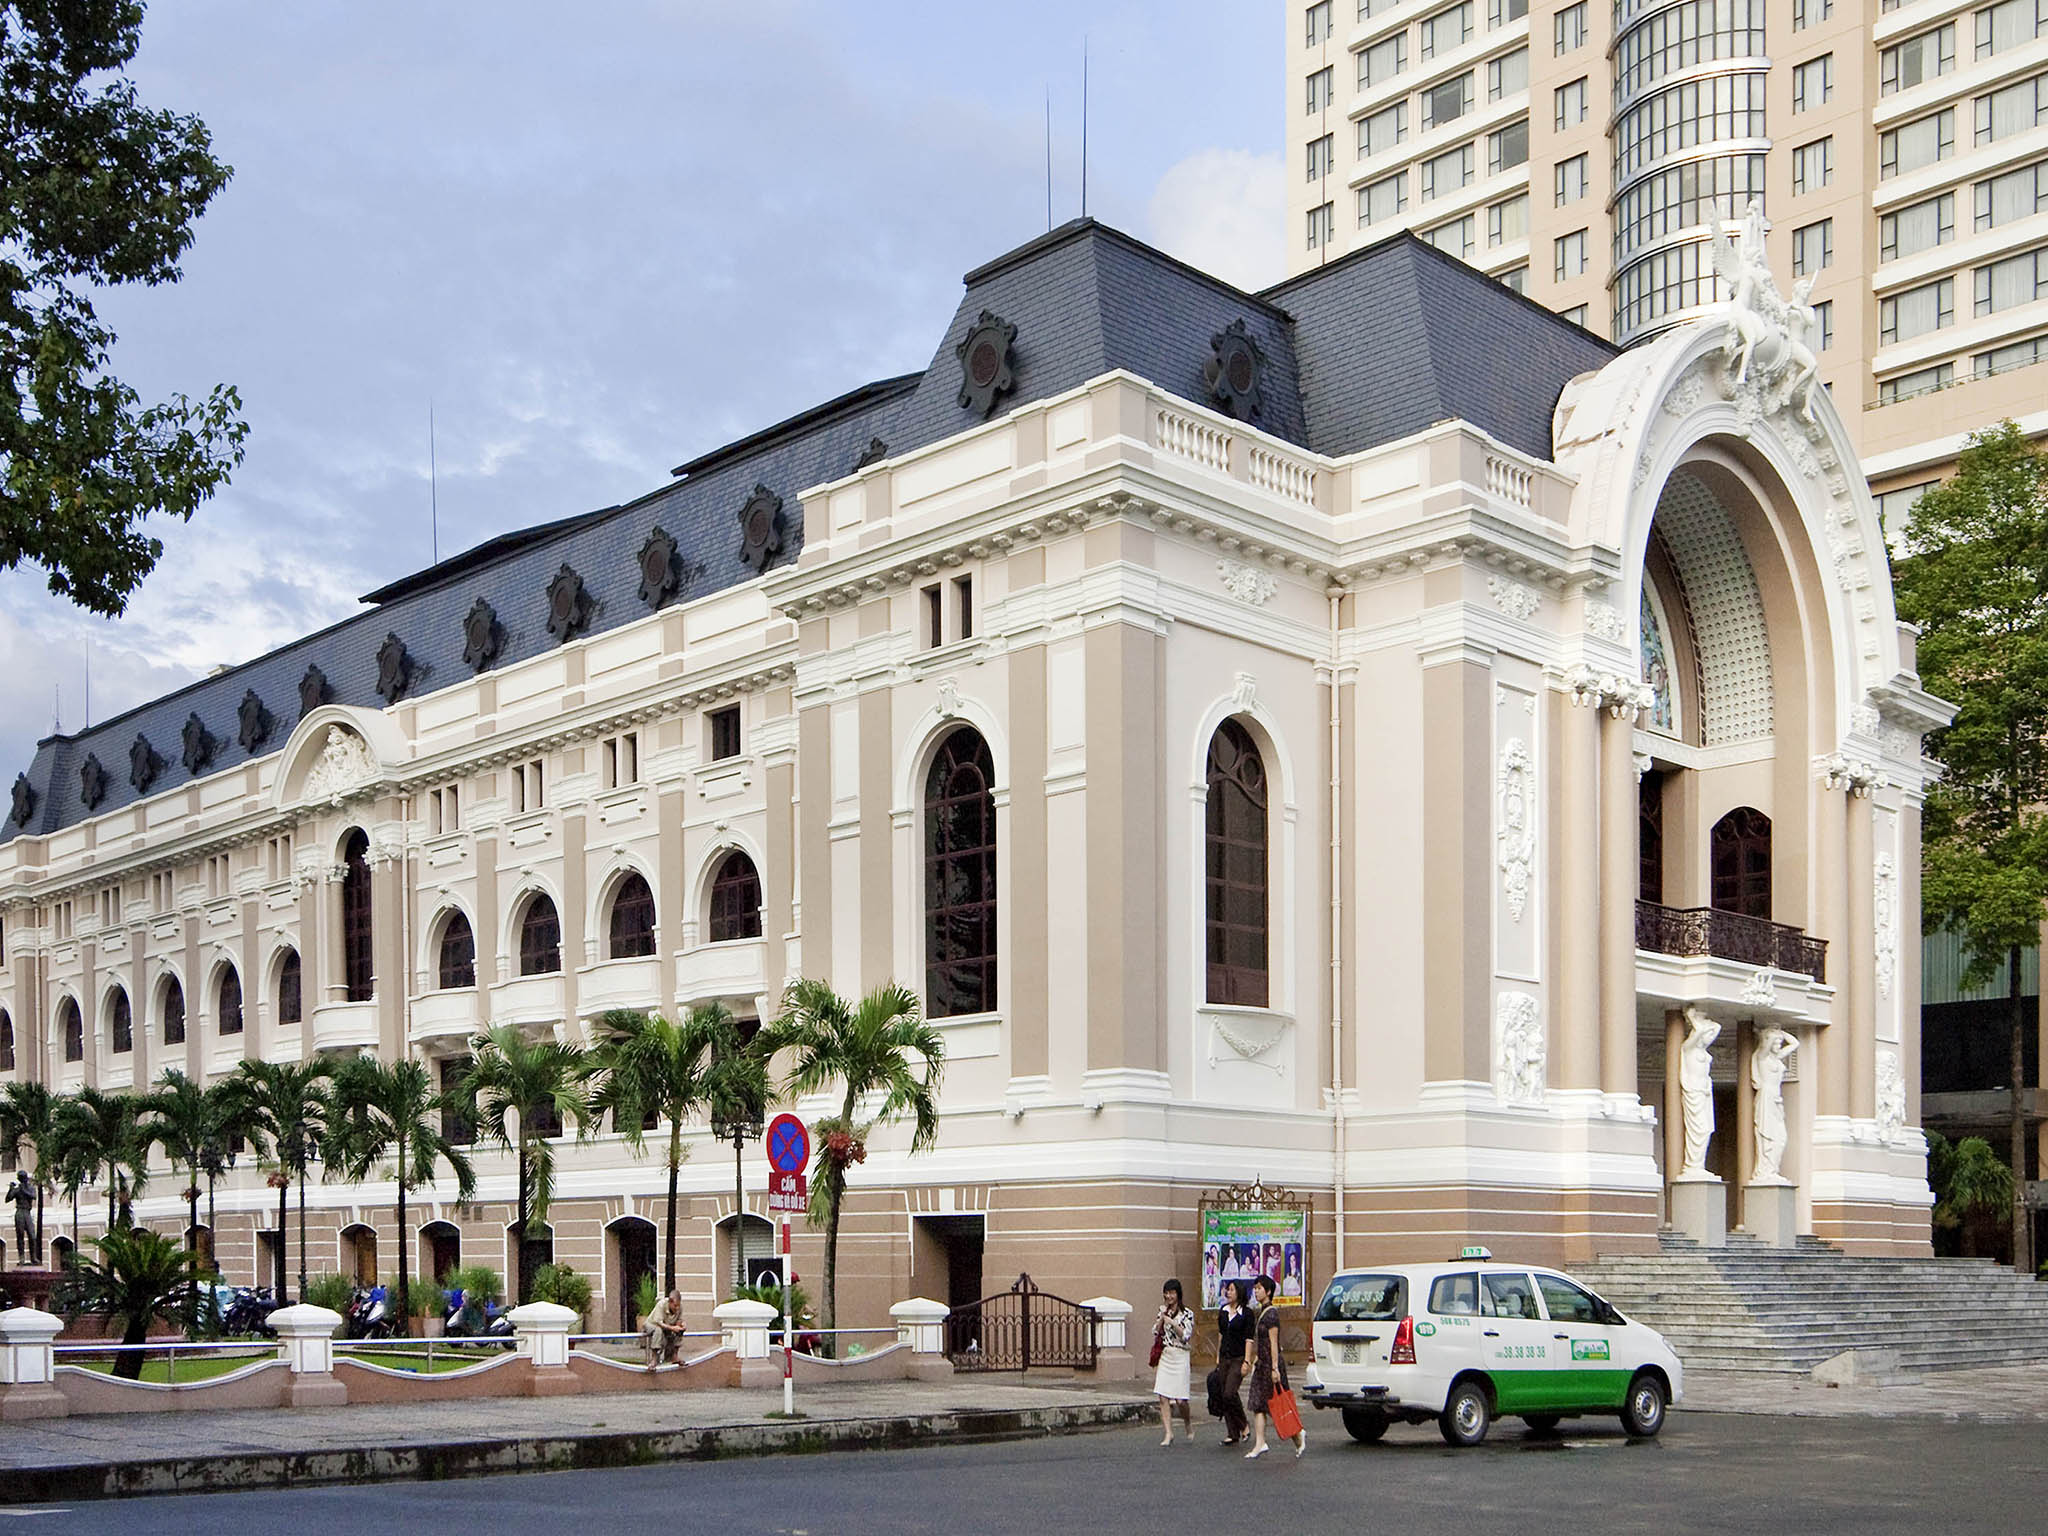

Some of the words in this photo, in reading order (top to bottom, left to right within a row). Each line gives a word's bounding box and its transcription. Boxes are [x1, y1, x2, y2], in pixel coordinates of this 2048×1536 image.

[781, 1175, 796, 1192] CẤM
[1526, 1346, 1535, 1358] 38
[1537, 1346, 1545, 1358] 38
